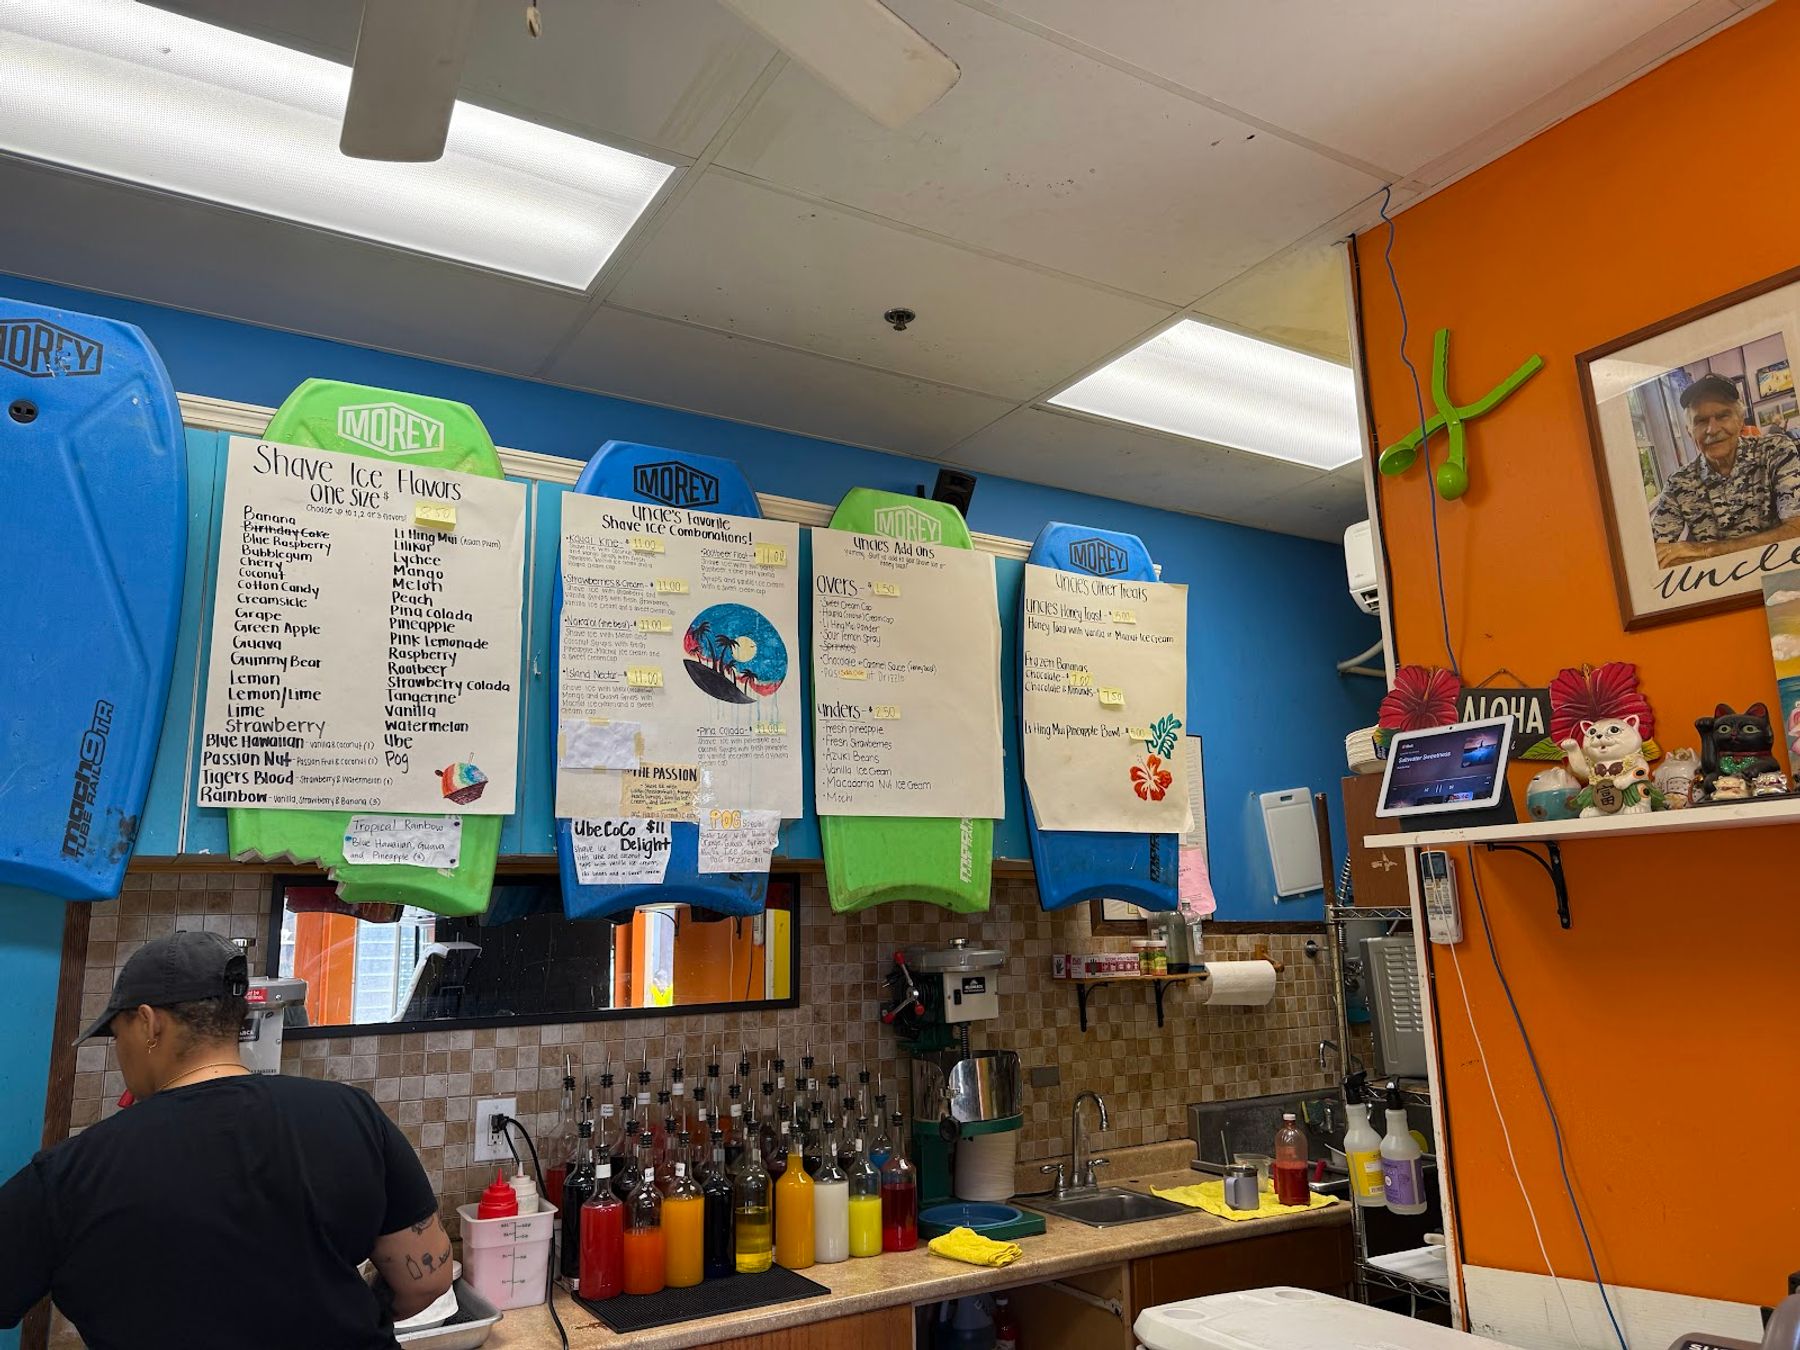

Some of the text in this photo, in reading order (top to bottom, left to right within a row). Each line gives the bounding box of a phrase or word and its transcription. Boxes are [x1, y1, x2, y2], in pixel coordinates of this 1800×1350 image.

[346, 407, 438, 450] MOREY
[253, 444, 461, 500] Shave Ice Flavors
[640, 465, 713, 504] MOREY
[244, 505, 296, 525] Banana
[602, 514, 640, 532] Shave
[688, 511, 731, 531] Favorite
[880, 509, 937, 543] MOREY
[243, 532, 331, 556] Blue Raspberry
[394, 528, 458, 546] Li Hing Mui
[242, 544, 312, 563] Bubblegum
[894, 542, 913, 557] Add
[1073, 542, 1125, 573] MOREY
[240, 557, 282, 571] Cherry
[393, 552, 441, 568] Lychee
[240, 567, 284, 580] Coconut
[393, 565, 443, 580] Mango
[238, 580, 320, 599] Cotton Candy
[392, 578, 443, 592] Melon
[237, 593, 307, 608] Creamsicle
[392, 591, 433, 607] Peach
[235, 608, 282, 622] Grape
[1060, 603, 1083, 622] Honey
[1084, 606, 1102, 621] Toast
[234, 620, 320, 637] Green Apple
[389, 617, 456, 633] Pineapple
[1028, 616, 1050, 636] Honey
[233, 635, 281, 650] Guava
[390, 632, 420, 647] Pink
[822, 629, 839, 640] Sour
[230, 652, 321, 672] Gummy Bear
[388, 647, 457, 667] Raspberry
[1024, 650, 1088, 672] Frozen Bananas
[388, 661, 448, 677] Rootbeer
[230, 670, 280, 685] Lemon
[387, 676, 462, 696] Strawberry
[1024, 681, 1061, 693] Chocolate
[228, 687, 322, 708] Lemon/Lime
[385, 688, 456, 706] Tangerine
[228, 703, 265, 717] Lime
[384, 705, 436, 718] Vanilla
[225, 716, 326, 739] Strawberry
[825, 721, 847, 734] Fresh
[1100, 724, 1121, 738] Bowl
[206, 733, 304, 749] Blue Hawaiian
[384, 733, 413, 749] Ube
[825, 735, 847, 747] Fresh
[203, 751, 291, 767] Passion Nut
[384, 750, 409, 774] Pog
[825, 748, 880, 763] Azuki Beans
[653, 767, 697, 782] PASSION
[826, 763, 892, 776] Vanilla Ice Cream
[202, 769, 249, 790] Tigers
[254, 770, 294, 785] Blood
[907, 781, 932, 790] Cream
[200, 786, 267, 803] Rainbow
[75, 766, 102, 858] TUBE RAIL
[710, 808, 741, 830] POG
[352, 818, 444, 836] Tropical Rainbow
[575, 820, 602, 838] Ube
[352, 837, 371, 848] Blue
[620, 837, 671, 860] Delight
[350, 851, 409, 862] and Pineapple
